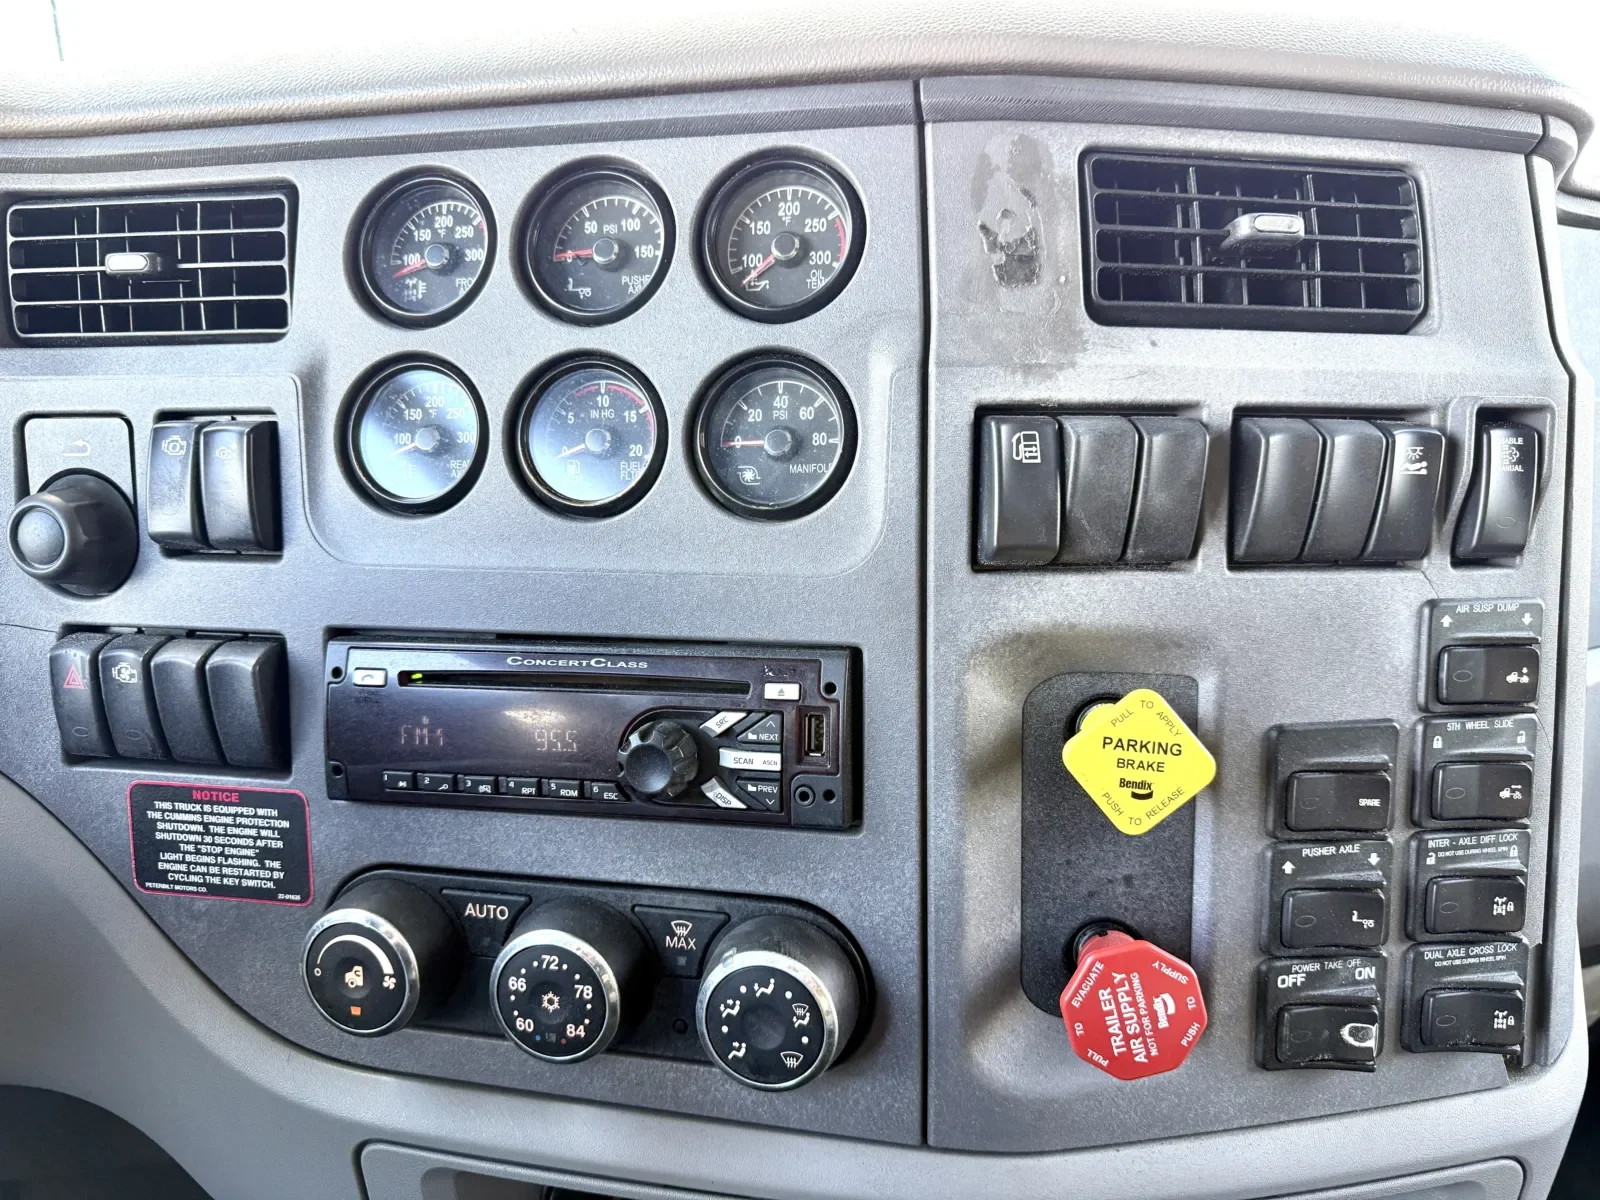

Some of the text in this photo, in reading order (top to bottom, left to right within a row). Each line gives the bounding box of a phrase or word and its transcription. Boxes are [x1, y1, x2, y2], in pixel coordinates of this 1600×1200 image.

[778, 202, 800, 216] 200
[435, 216, 453, 228] 200
[584, 220, 597, 234] 50
[621, 218, 640, 231] 100
[750, 220, 770, 235] 150
[805, 218, 826, 232] 250
[414, 229, 431, 241] 150
[455, 226, 474, 238] 250
[604, 224, 617, 234] PSI
[465, 248, 483, 261] 300
[635, 244, 654, 258] 150
[809, 251, 831, 264] 300
[403, 253, 420, 266] 100
[742, 254, 763, 267] 100
[810, 270, 824, 280] OIL
[426, 396, 444, 408] 200
[597, 396, 609, 407] 10
[773, 396, 788, 408] 40
[404, 409, 422, 420] 150
[447, 408, 465, 419] 250
[568, 412, 574, 424] 5
[591, 409, 614, 419] IN HG
[624, 411, 636, 423] 15
[748, 409, 762, 422] 20
[773, 410, 787, 420] PSI
[800, 408, 814, 419] 60
[394, 433, 412, 444] 100
[457, 432, 475, 443] 300
[812, 433, 826, 445] 80
[630, 444, 642, 456] 20
[620, 462, 641, 471] FUEL
[1456, 603, 1520, 613] AIR SUSP DUMP
[716, 716, 728, 728] SRC
[1111, 700, 1182, 737] PULL TO APPLY
[1447, 720, 1514, 731] 5TH WHEEL SLIDE
[1102, 737, 1182, 756] PARKING
[734, 757, 754, 765] SCAN
[1117, 758, 1165, 772] BRAKE
[758, 785, 778, 793] PREV
[1119, 778, 1152, 790] Bendix
[192, 790, 239, 802] NOTICE
[560, 789, 578, 797] RDM
[604, 792, 618, 800] ESC
[716, 792, 732, 805] DISP
[154, 801, 278, 817] THIS TRUCK IS EQUIPPED WITH
[1102, 787, 1185, 826] PUSH TO RELEASE
[147, 811, 289, 828] THE CUMMINS ENGINE PROTECTION
[157, 822, 280, 838] SHUTDOWN. THE ENGINE WILL
[155, 832, 201, 842] SHUTDOWN
[214, 836, 254, 846] SECONDS
[256, 839, 283, 848] AFTER
[1428, 833, 1518, 848] INTER AXLE DIFF LOCK
[179, 844, 196, 852] THE
[1302, 844, 1360, 857] PUSHER AXLE
[160, 852, 281, 868] LIGHT BEGINS FLASHING. THE
[158, 862, 284, 879] ENGINE CAN BE RESTARTED BY
[146, 882, 174, 890] PETERBILT
[168, 873, 203, 883] CYCLING
[204, 876, 221, 884] THE
[242, 879, 276, 889] SWITCH.
[465, 902, 509, 920] AUTO
[666, 936, 696, 950] MAX
[1424, 943, 1517, 960] DUAL AXLE CROSS LOCK
[541, 956, 558, 970] 72
[1292, 959, 1361, 973] POWER TAKE OFF
[1355, 967, 1376, 980] ON
[508, 977, 526, 991] 66
[1277, 974, 1306, 988] OFF
[574, 985, 592, 999] 78
[1152, 960, 1200, 1047] PUSH TO SUPPLY
[1071, 961, 1109, 1068] PULL TO EVACUATE
[1112, 972, 1148, 1063] AIR SUPPLY
[1130, 972, 1159, 1056] NOT FOR PARKING
[516, 1018, 534, 1032] 60
[1098, 987, 1127, 1056] TRAILER
[566, 1024, 585, 1038] 84
